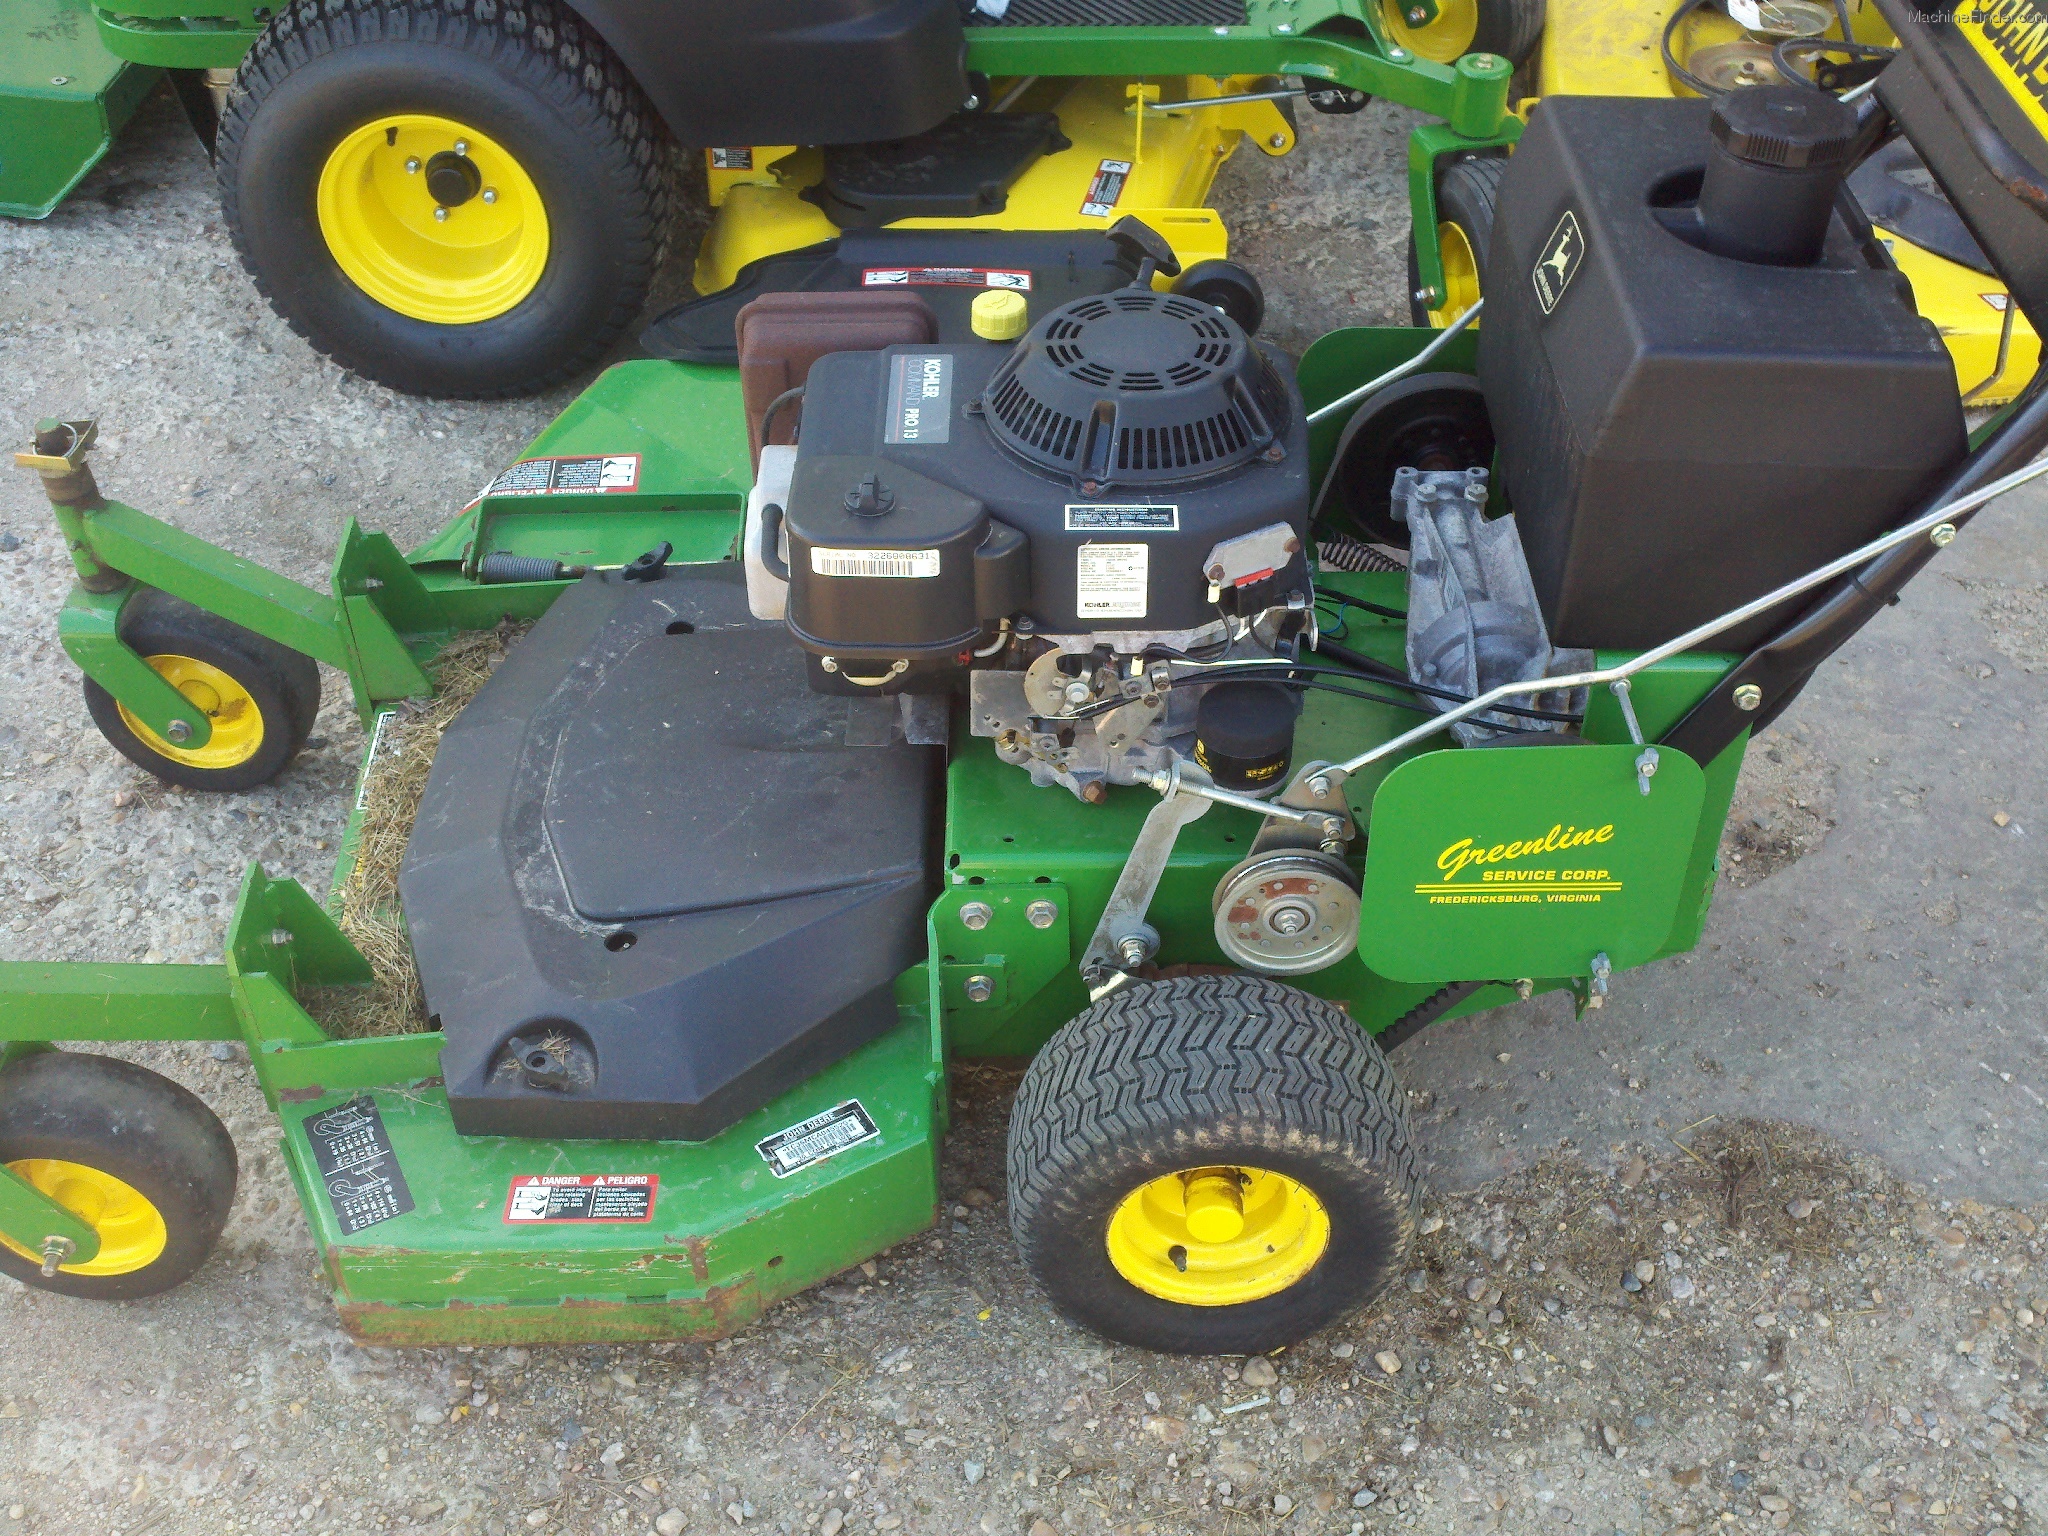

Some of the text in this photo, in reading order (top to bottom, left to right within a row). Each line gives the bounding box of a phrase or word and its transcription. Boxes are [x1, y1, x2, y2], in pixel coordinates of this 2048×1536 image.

[922, 359, 942, 399] KOHLER
[904, 408, 920, 428] PRO
[903, 429, 919, 440] 13
[1437, 823, 1615, 881] Greenline
[1482, 870, 1612, 881] SERVICE CORP.
[1430, 894, 1602, 904] FREDERICKSBURG, VIRGINIA
[541, 1176, 581, 1185] DANGER
[607, 1176, 648, 1185] PELIGRO
